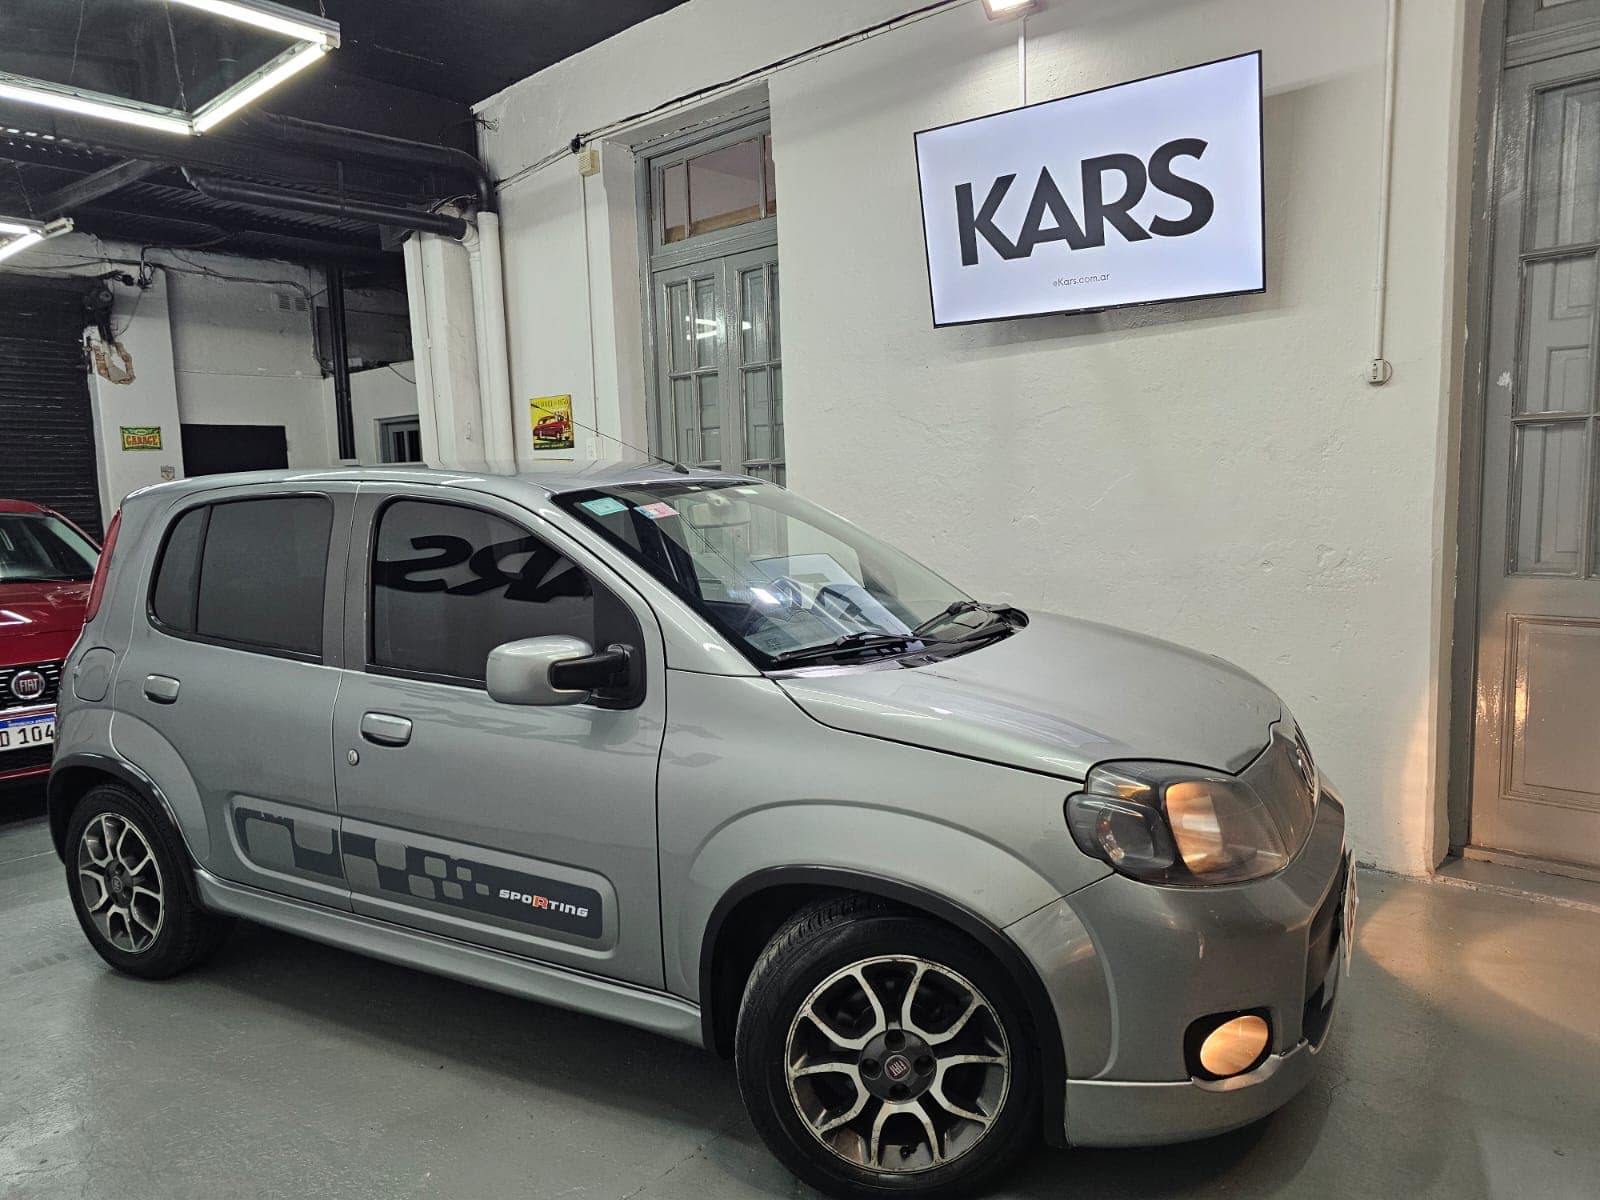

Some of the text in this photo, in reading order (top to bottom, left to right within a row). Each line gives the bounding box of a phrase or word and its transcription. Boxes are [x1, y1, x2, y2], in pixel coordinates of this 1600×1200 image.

[955, 138, 1215, 267] KARS
[1052, 273, 1111, 287] eKars.com.ar
[126, 435, 158, 446] GARAGE
[19, 678, 38, 692] FIAT
[18, 724, 54, 744] 104
[499, 889, 589, 918] SPORTING
